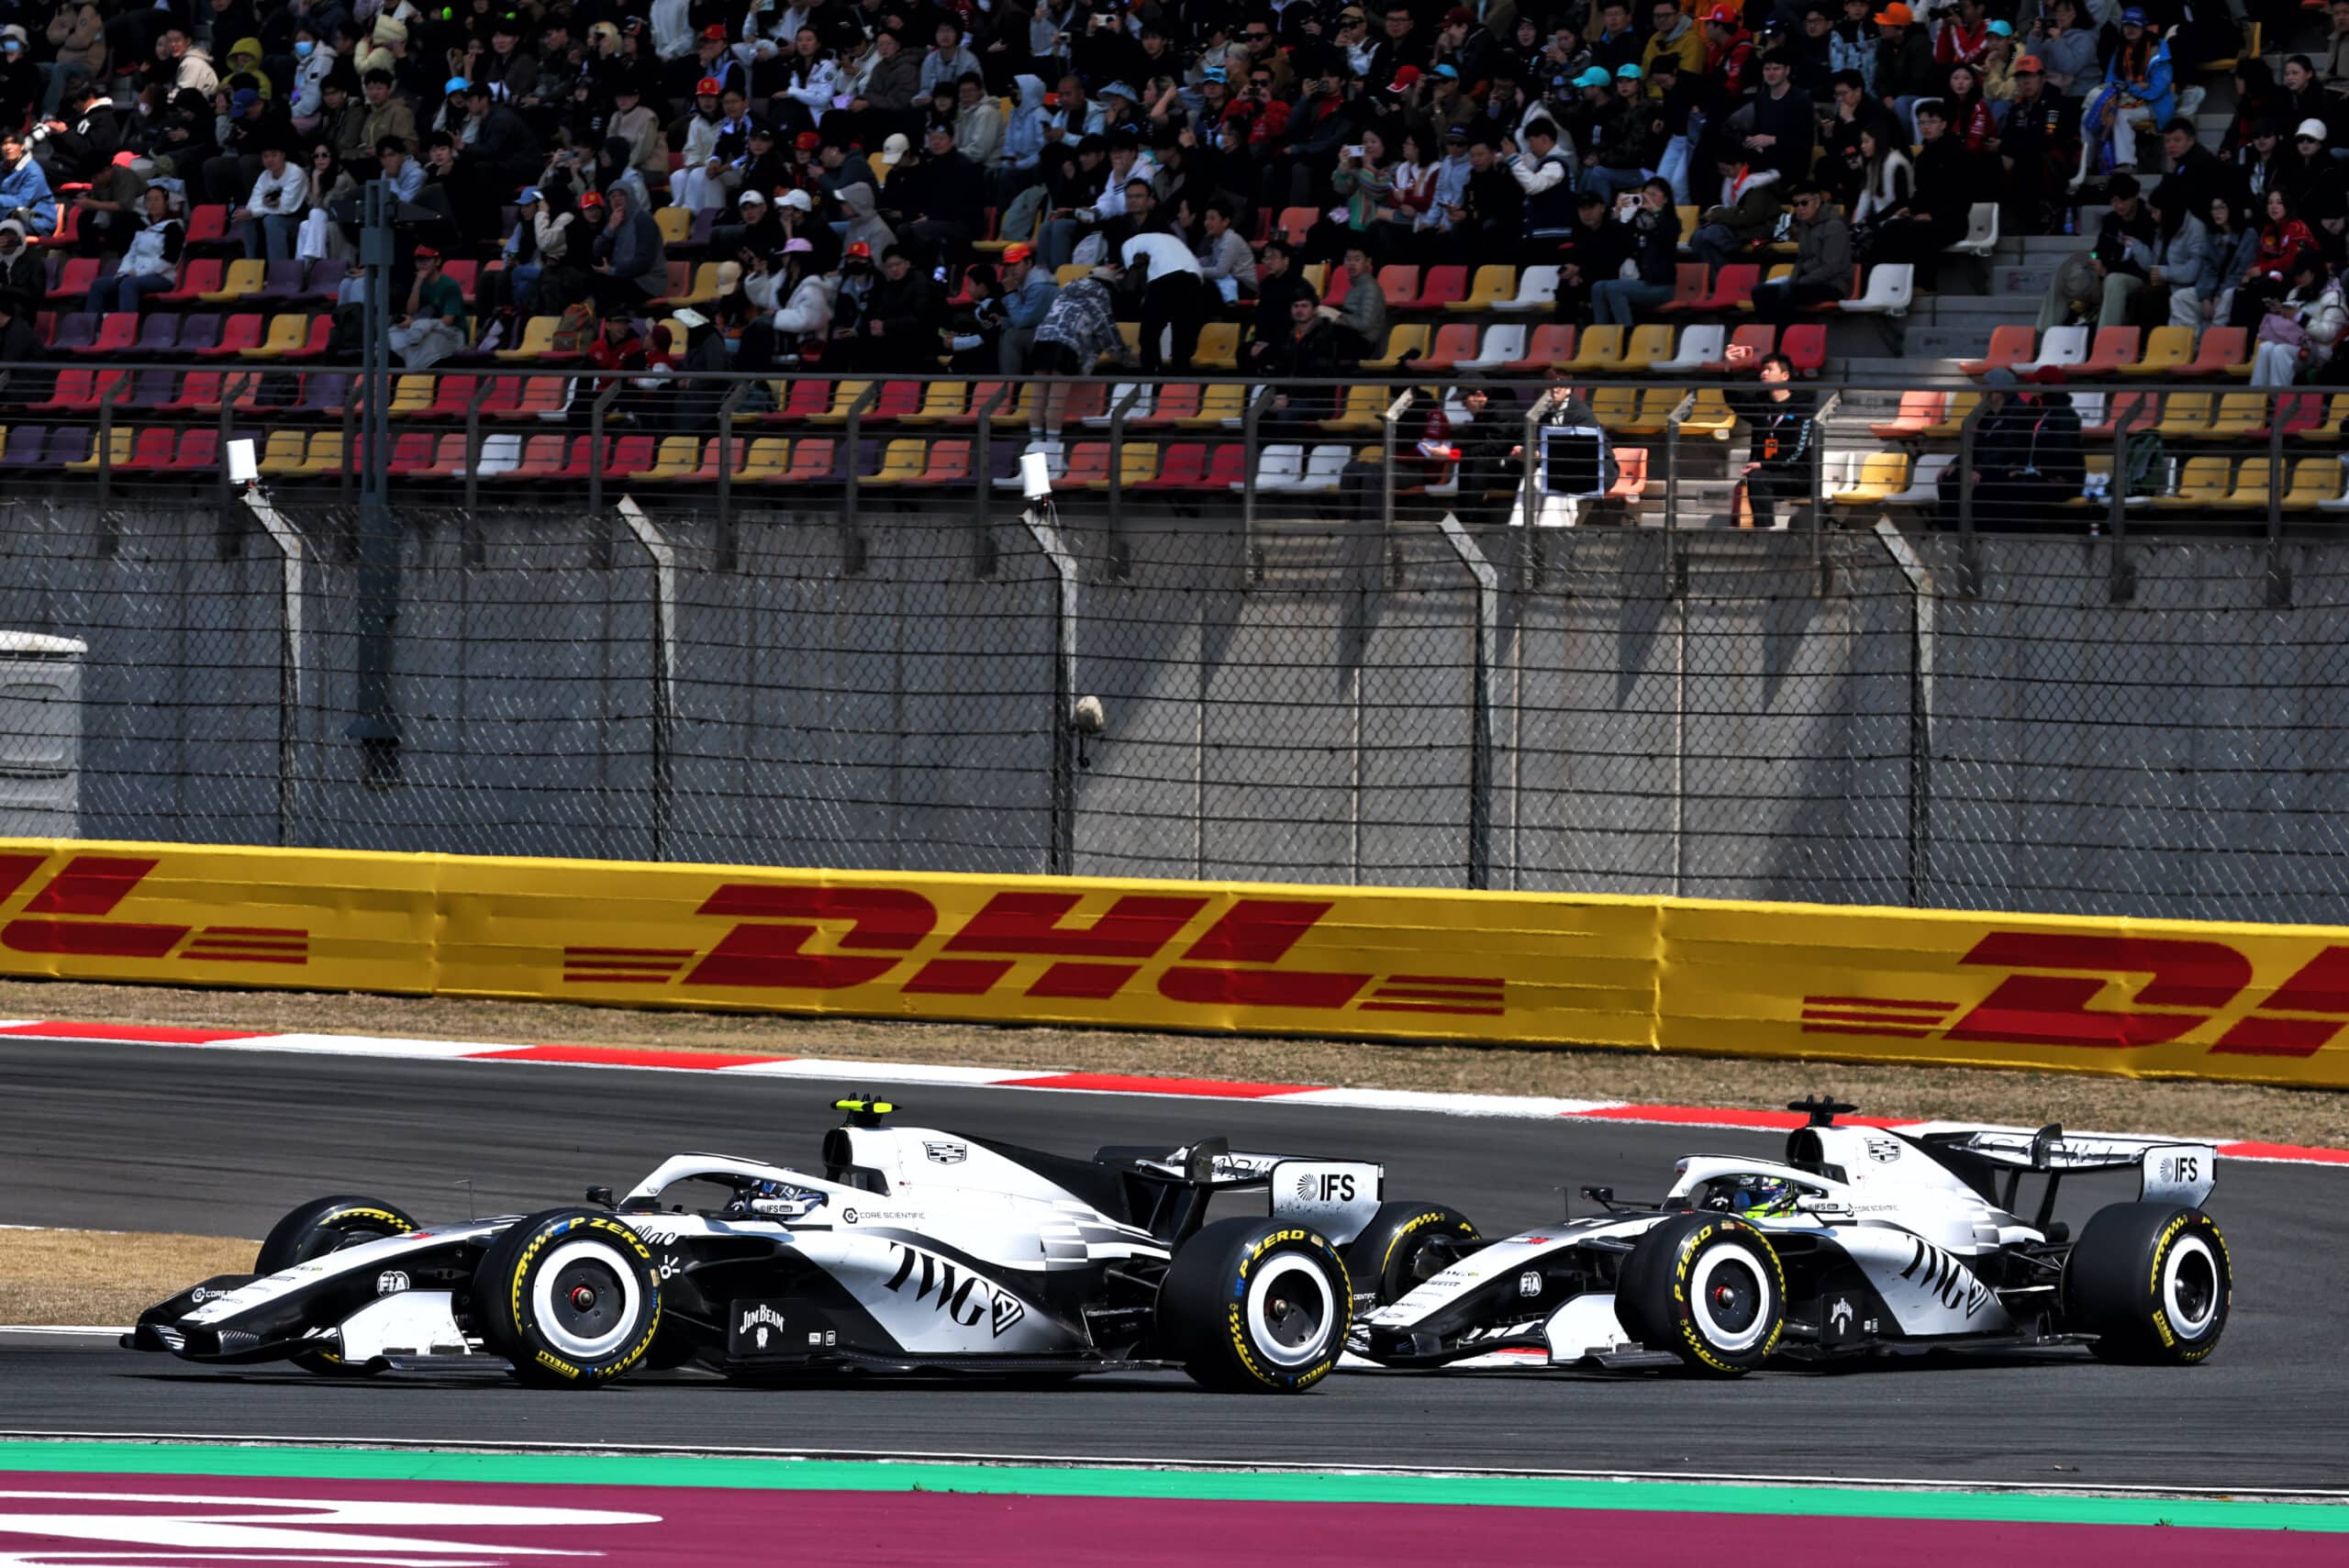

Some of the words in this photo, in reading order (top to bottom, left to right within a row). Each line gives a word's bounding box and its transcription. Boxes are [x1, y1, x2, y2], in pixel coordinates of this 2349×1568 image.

[681, 884, 1375, 1008] DHL
[1319, 1173, 1355, 1202] IFS
[2175, 1157, 2198, 1182] IFS
[569, 1217, 585, 1229] P
[589, 1218, 651, 1259] ZERO
[1240, 1259, 1249, 1279] P
[1252, 1229, 1306, 1261] ZERO
[1676, 1225, 1713, 1282] ZERO
[883, 1241, 989, 1327] TWG
[1674, 1284, 1684, 1302] P
[740, 1309, 760, 1334] JIM
[760, 1304, 785, 1333] BEAM
[536, 1351, 580, 1379] PIRELLI
